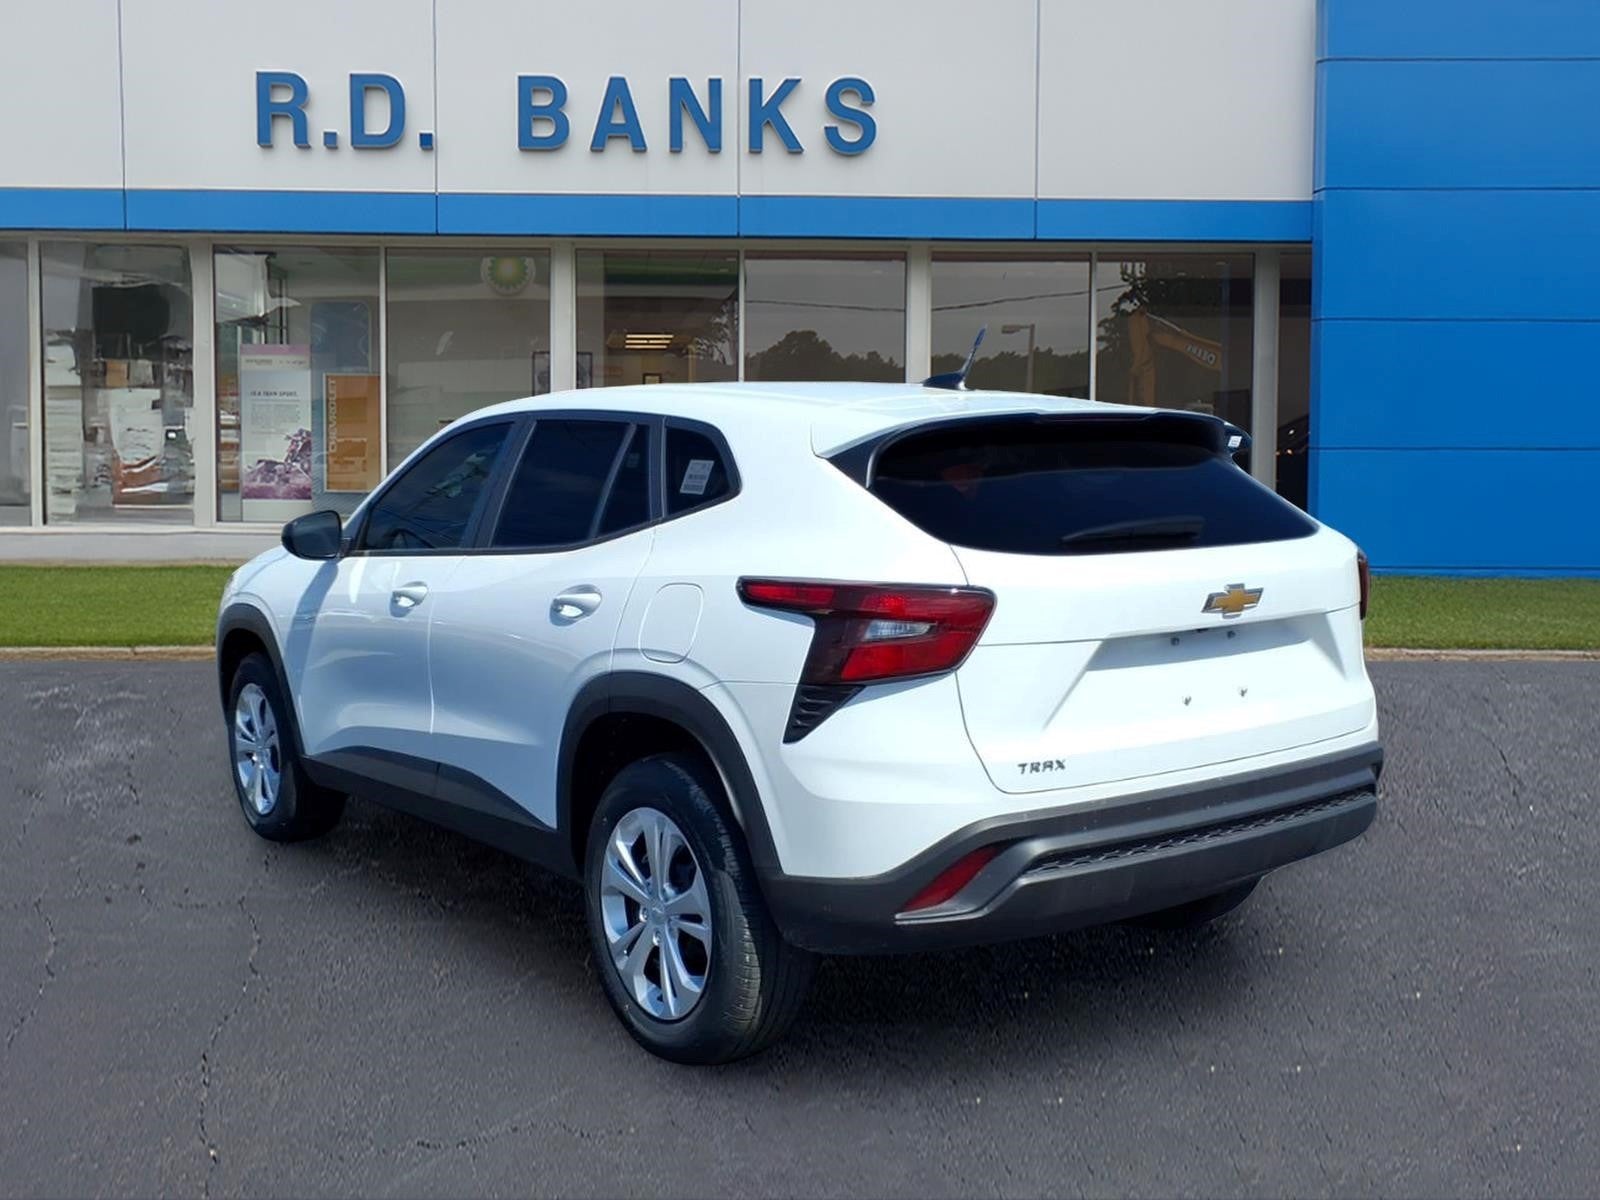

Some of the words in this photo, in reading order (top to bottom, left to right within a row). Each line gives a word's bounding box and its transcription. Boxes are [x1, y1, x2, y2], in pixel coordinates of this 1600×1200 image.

[256, 71, 434, 150] R.D.
[517, 74, 877, 155] BANKS
[1017, 759, 1066, 775] TRAX
